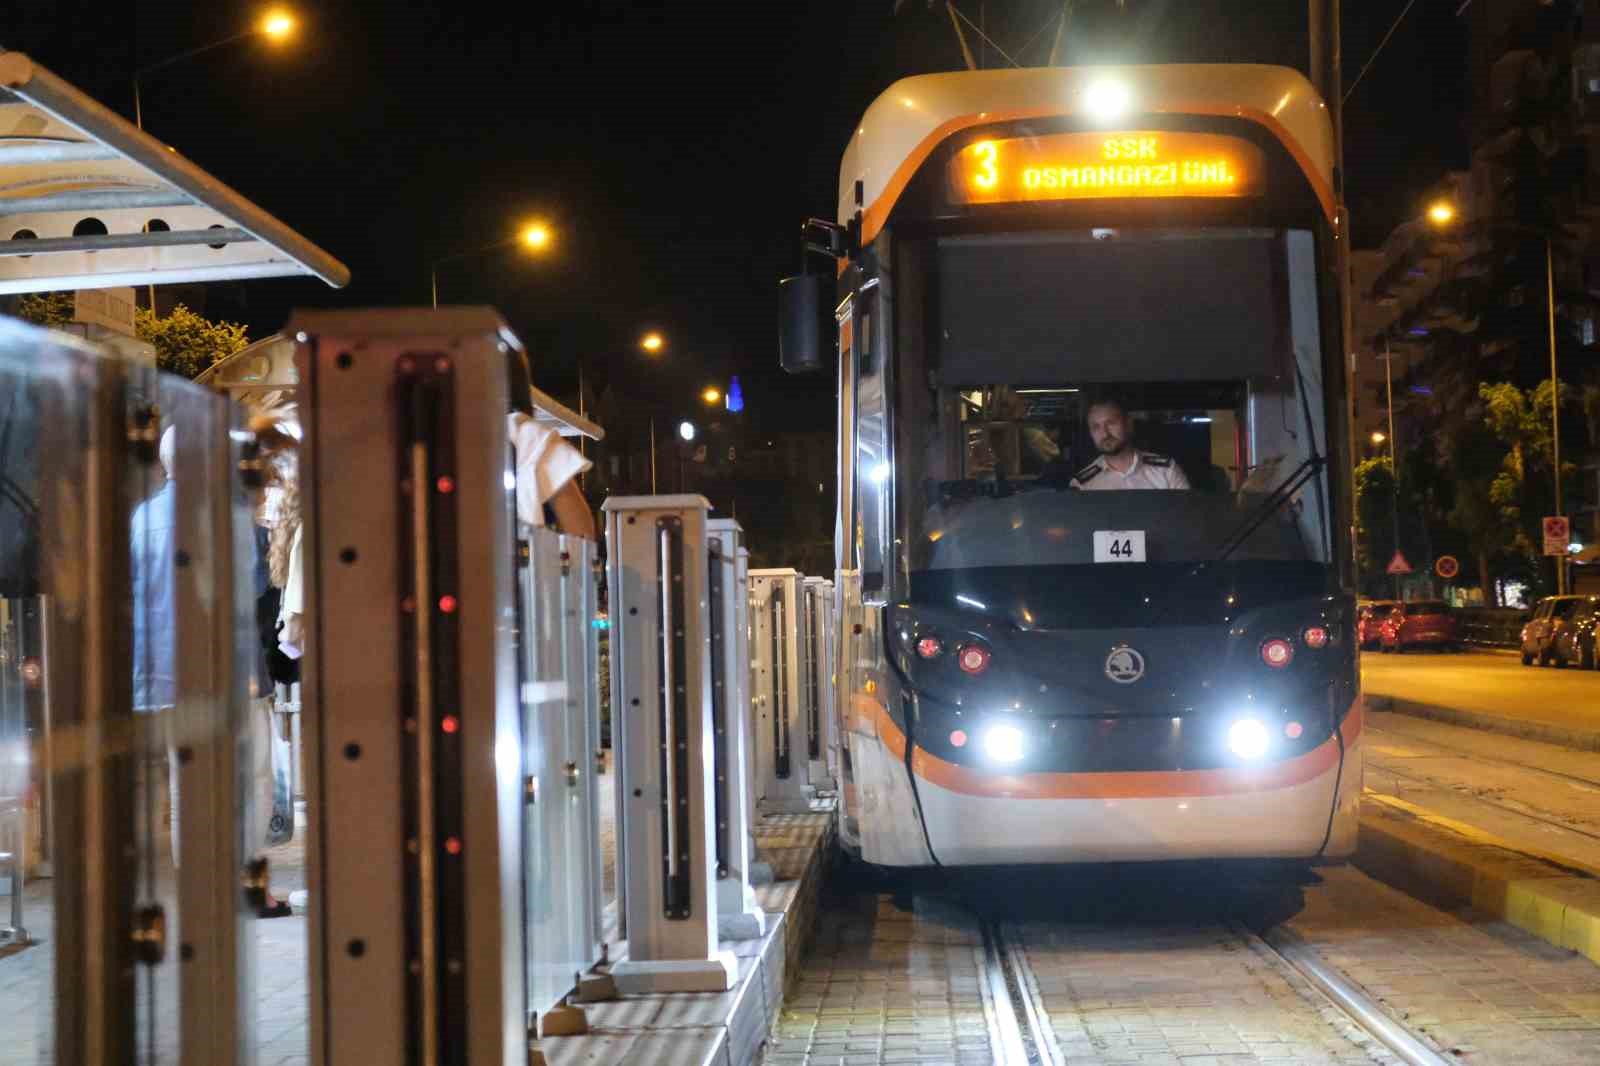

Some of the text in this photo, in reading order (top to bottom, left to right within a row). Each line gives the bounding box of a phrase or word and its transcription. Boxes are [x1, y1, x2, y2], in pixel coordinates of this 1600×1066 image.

[1104, 138, 1157, 160] SSK
[974, 140, 999, 189] 3
[1110, 539, 1133, 558] 44
